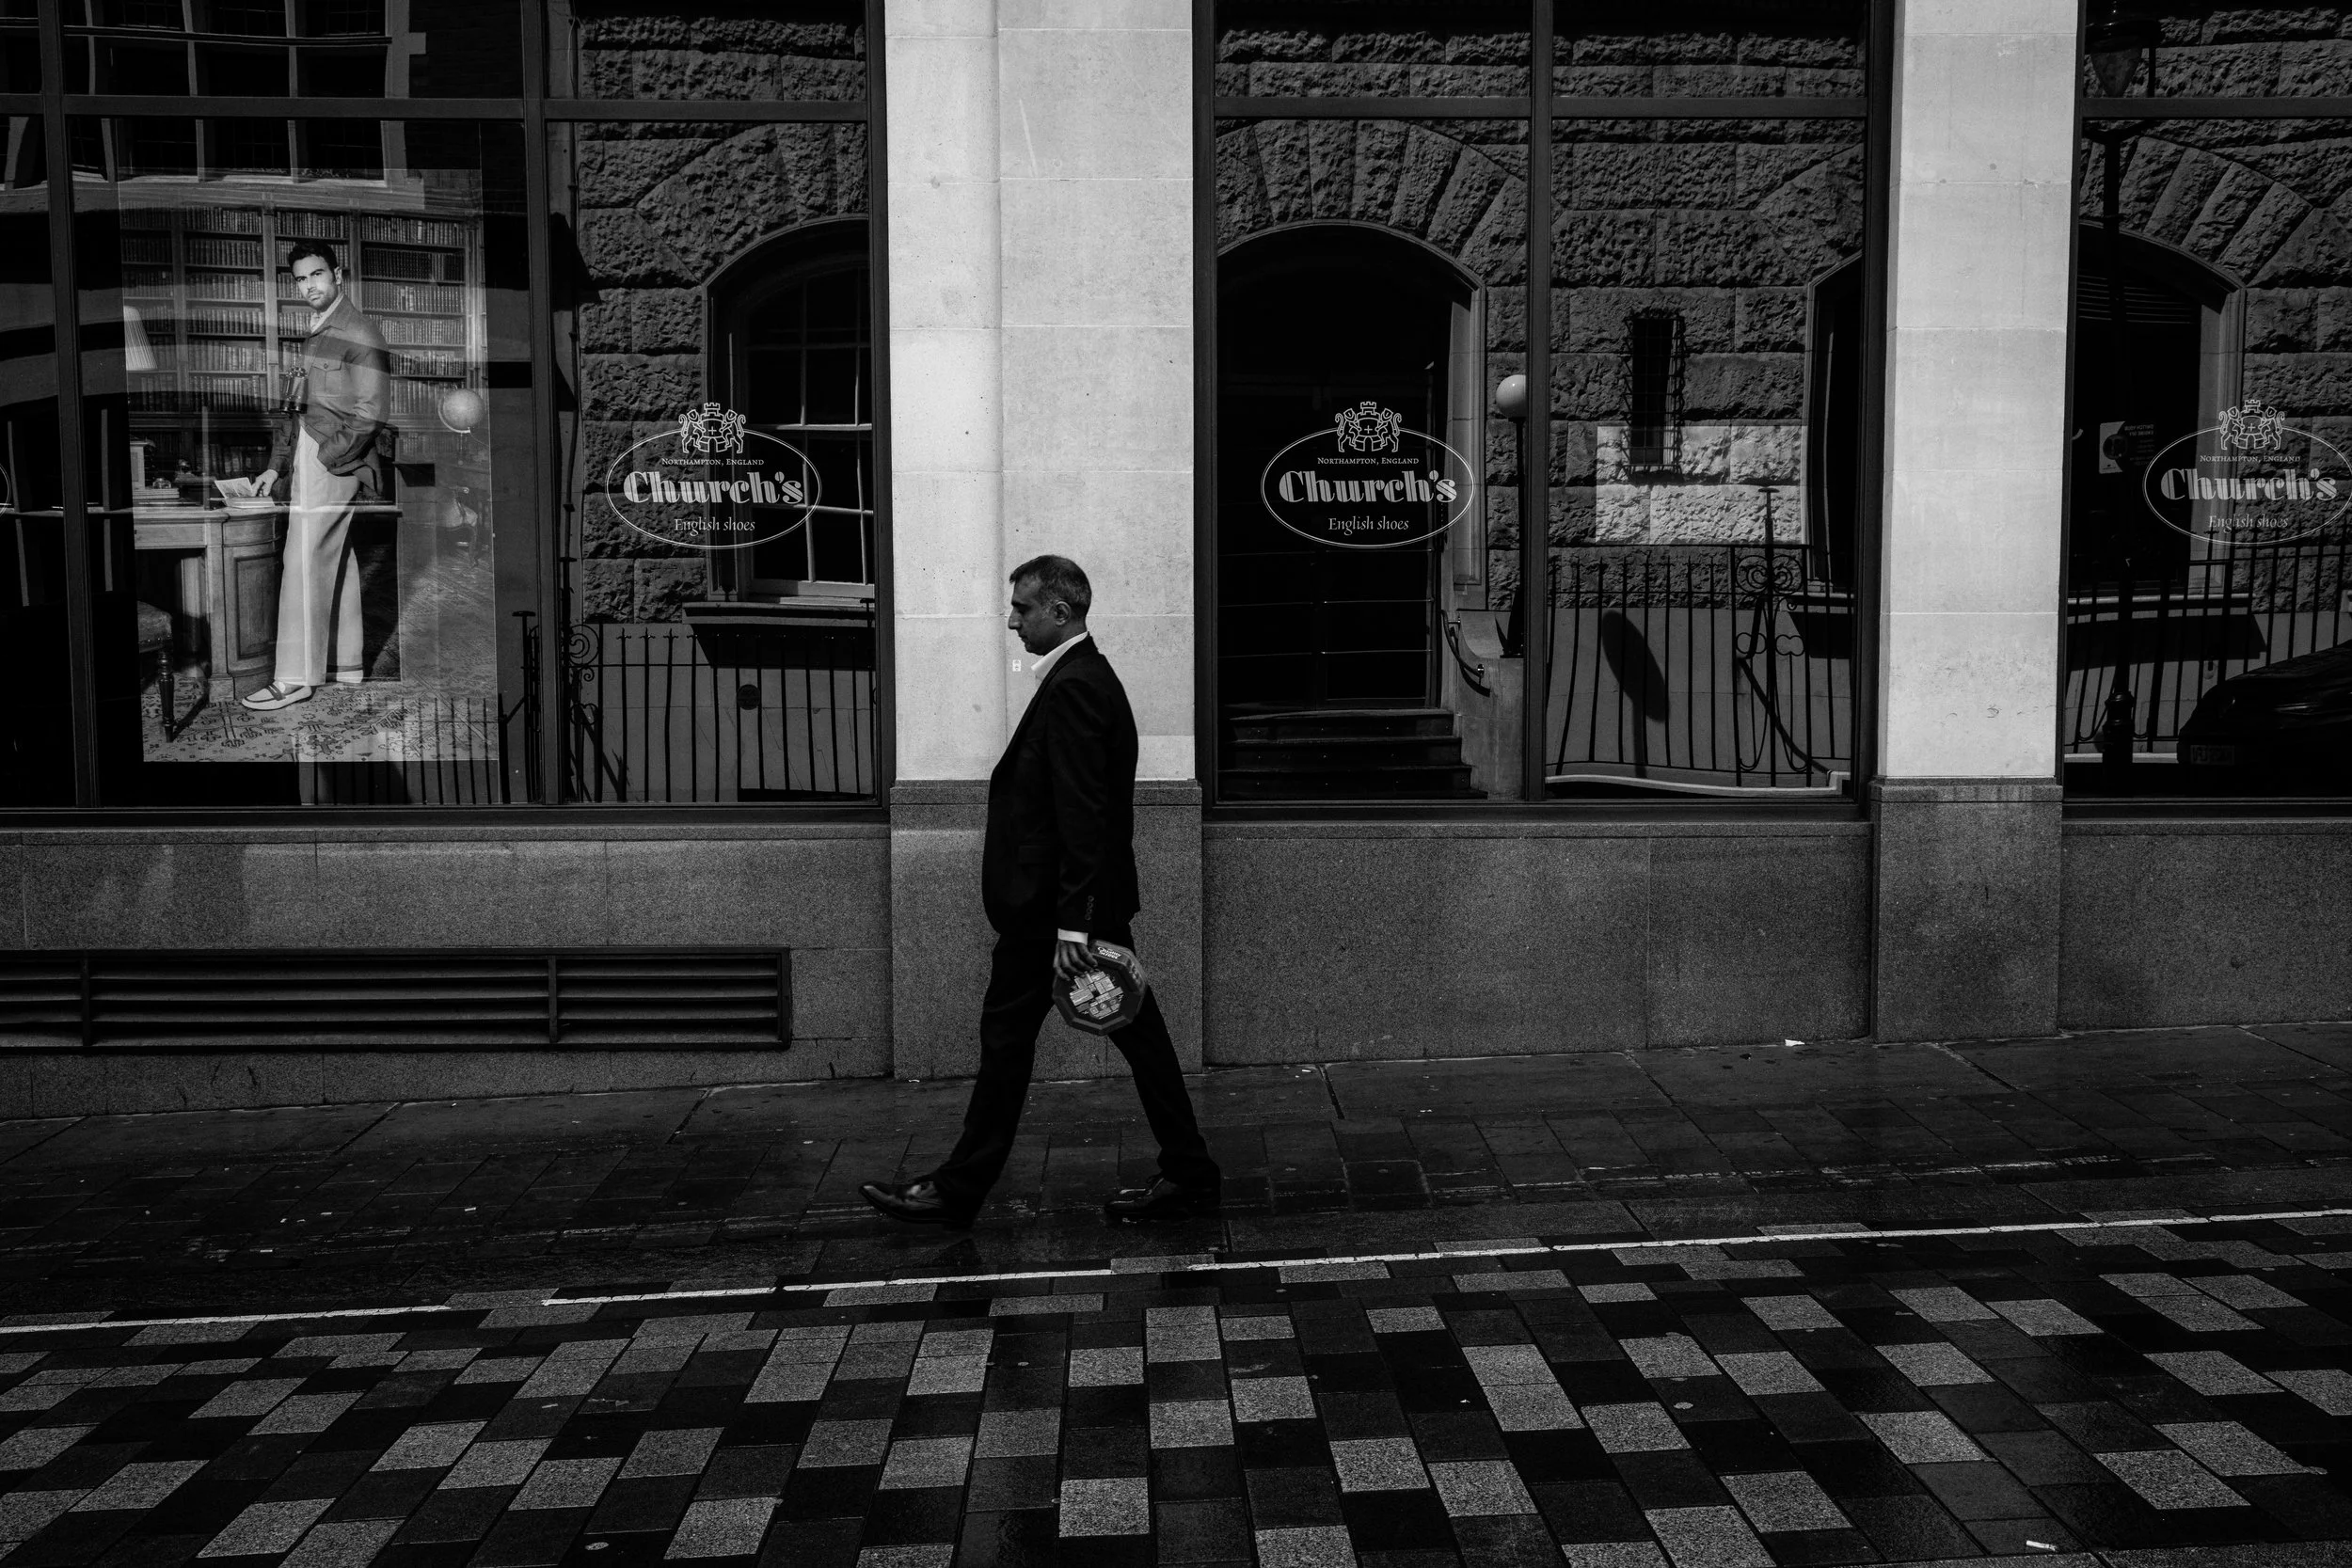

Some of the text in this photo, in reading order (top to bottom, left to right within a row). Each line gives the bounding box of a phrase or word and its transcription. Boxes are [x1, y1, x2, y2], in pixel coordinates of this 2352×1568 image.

[623, 470, 804, 504] Church's
[1279, 469, 1457, 503] Church's
[2160, 467, 2338, 501] Church's
[674, 516, 755, 537] English shoes
[1328, 515, 1409, 536] English shoes
[2208, 514, 2289, 534] English shoes
